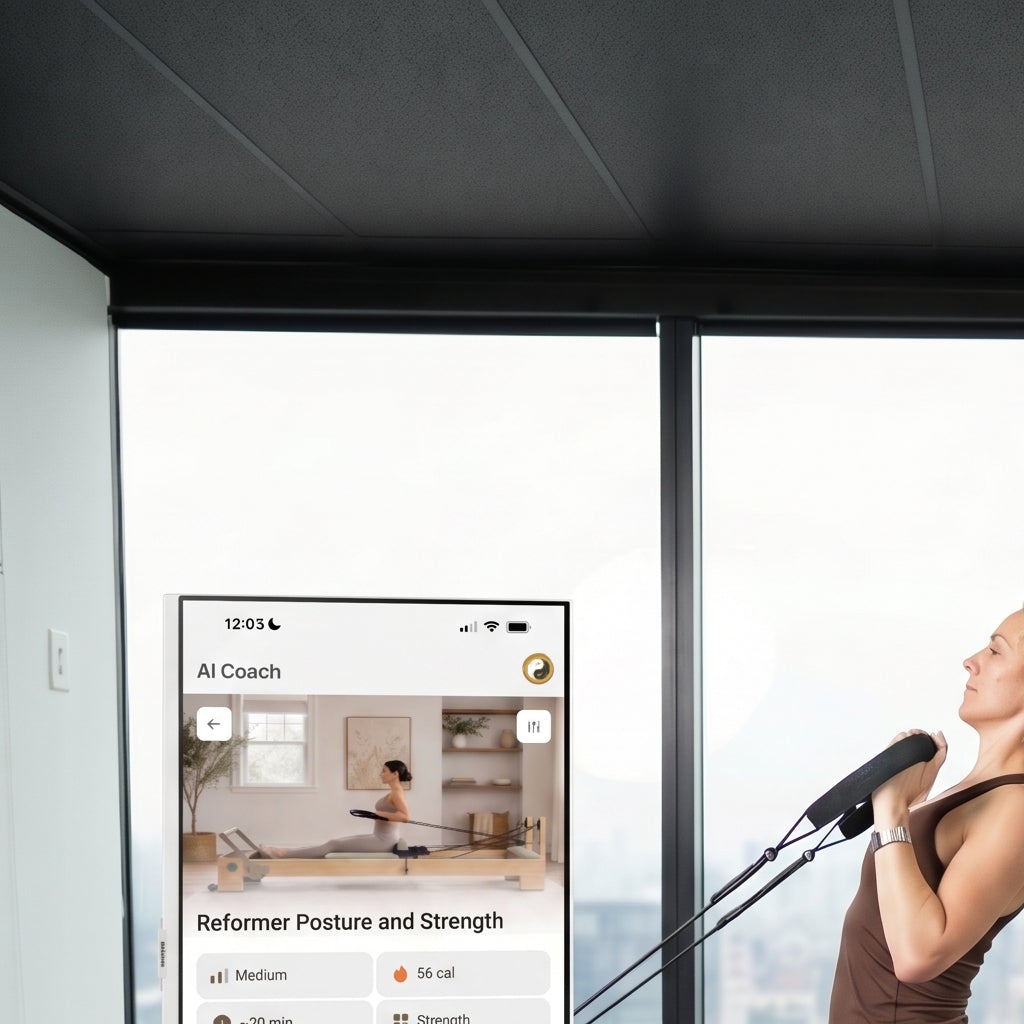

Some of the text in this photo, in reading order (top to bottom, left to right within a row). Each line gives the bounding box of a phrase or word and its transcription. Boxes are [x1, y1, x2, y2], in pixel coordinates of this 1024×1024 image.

[224, 617, 265, 631] 12:03
[196, 662, 282, 680] AI Coach
[197, 910, 504, 934] Reformer Posture and Strength
[235, 968, 288, 982] Medium
[417, 965, 455, 980] 56 cal
